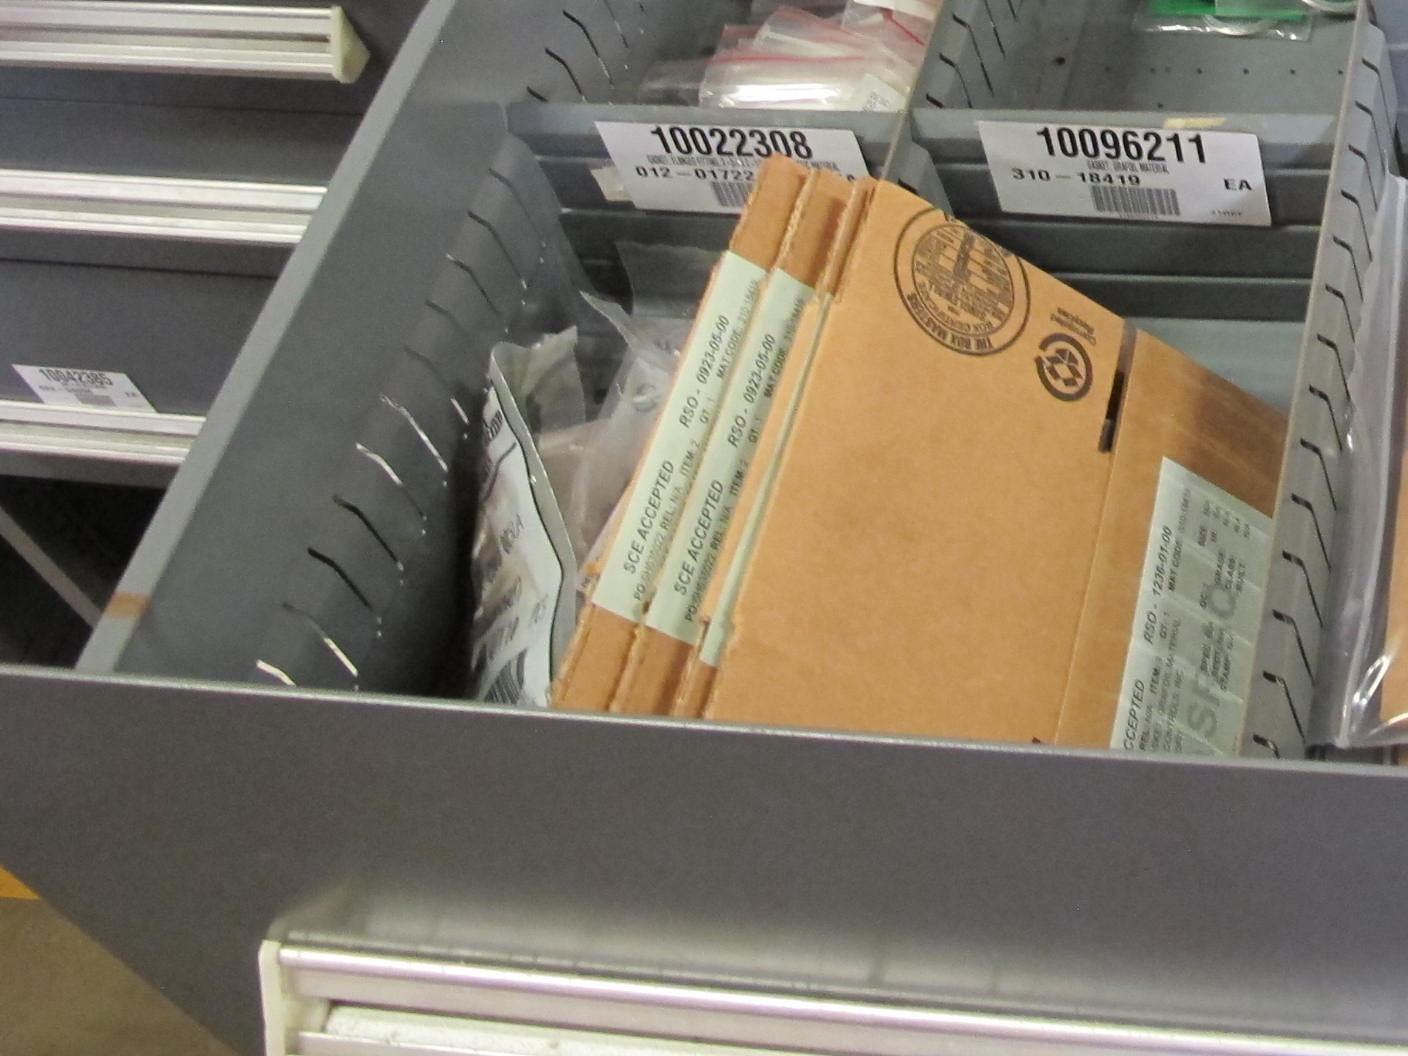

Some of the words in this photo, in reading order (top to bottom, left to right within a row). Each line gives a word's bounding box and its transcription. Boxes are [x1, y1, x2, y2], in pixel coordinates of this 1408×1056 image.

[651, 125, 813, 159] 10022308
[1037, 126, 1207, 164] 10096211
[1224, 178, 1252, 191] EA
[622, 539, 645, 574] SCE
[634, 458, 675, 542] ACCEPTED
[677, 393, 700, 429] RSO
[672, 560, 696, 596] SCE
[684, 478, 725, 562] ACCEPTED
[726, 414, 748, 448] RSO
[1142, 610, 1158, 644] RSO
